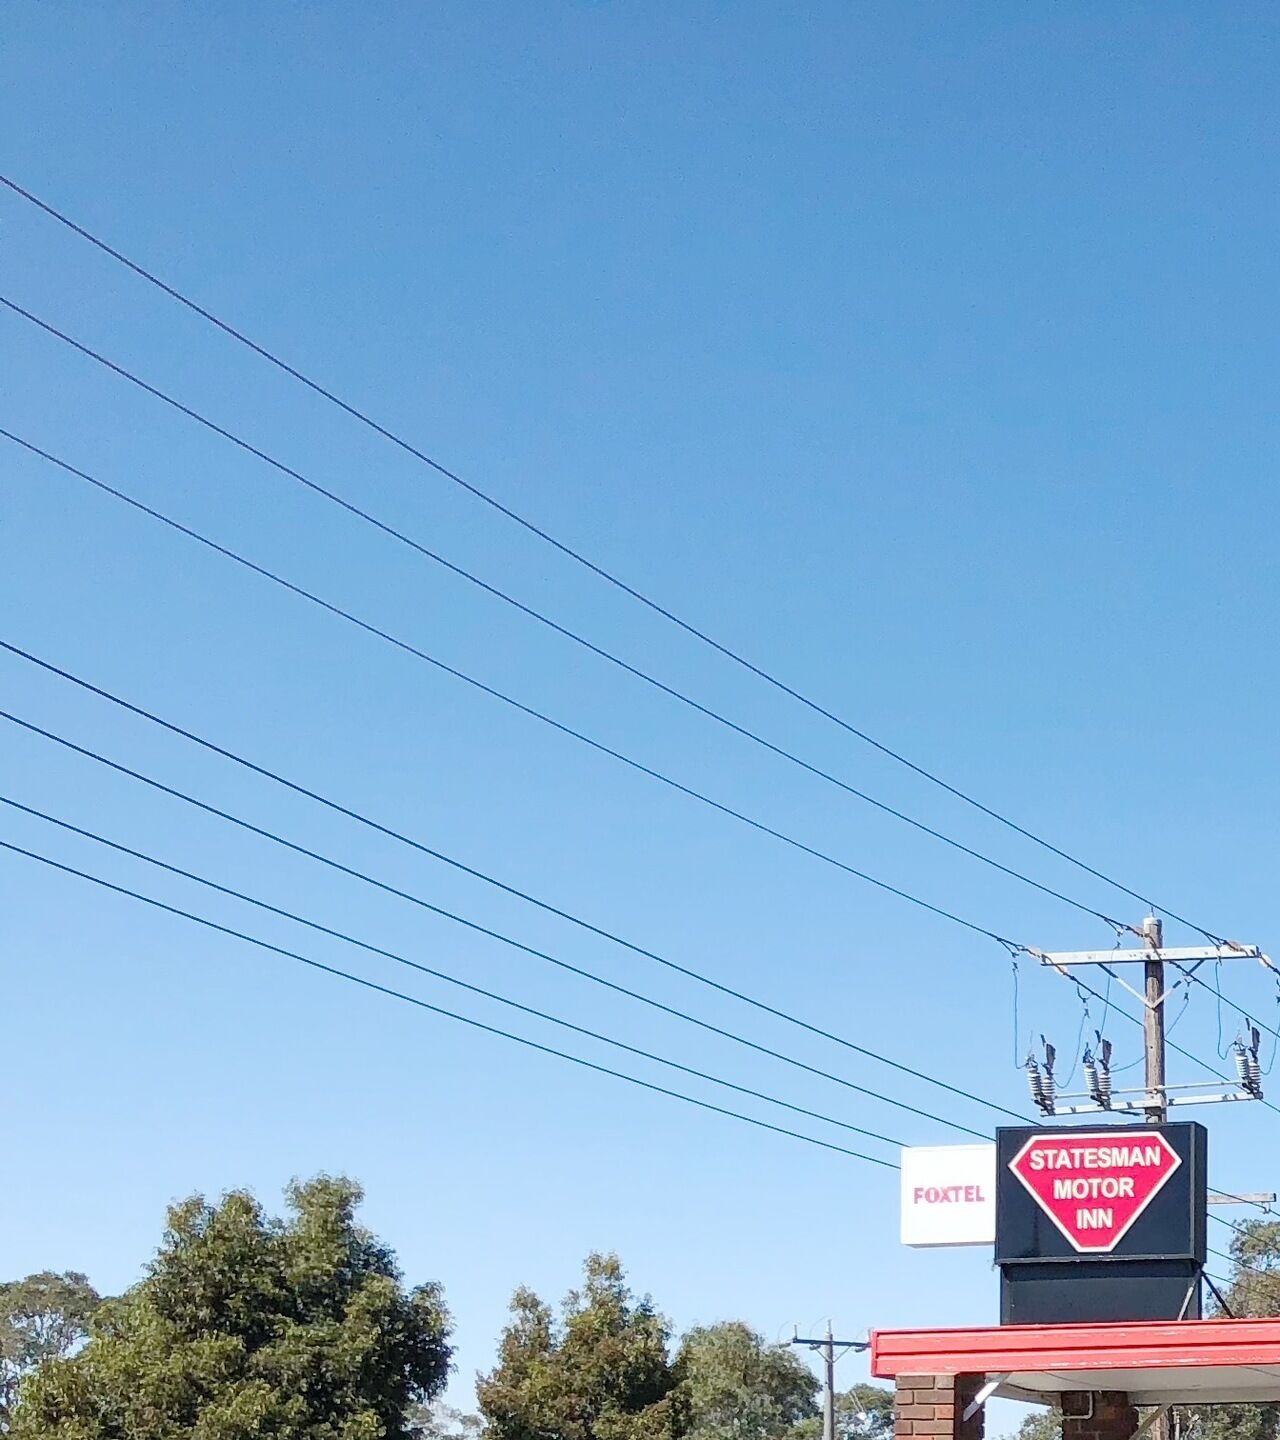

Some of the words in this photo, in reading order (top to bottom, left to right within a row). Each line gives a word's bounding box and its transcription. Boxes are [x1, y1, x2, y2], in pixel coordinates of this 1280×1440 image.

[1029, 1146, 1161, 1171] STATESMAN
[913, 1185, 985, 1205] FOXTEL
[1053, 1177, 1135, 1200] MOTOR
[1076, 1208, 1113, 1230] INN
